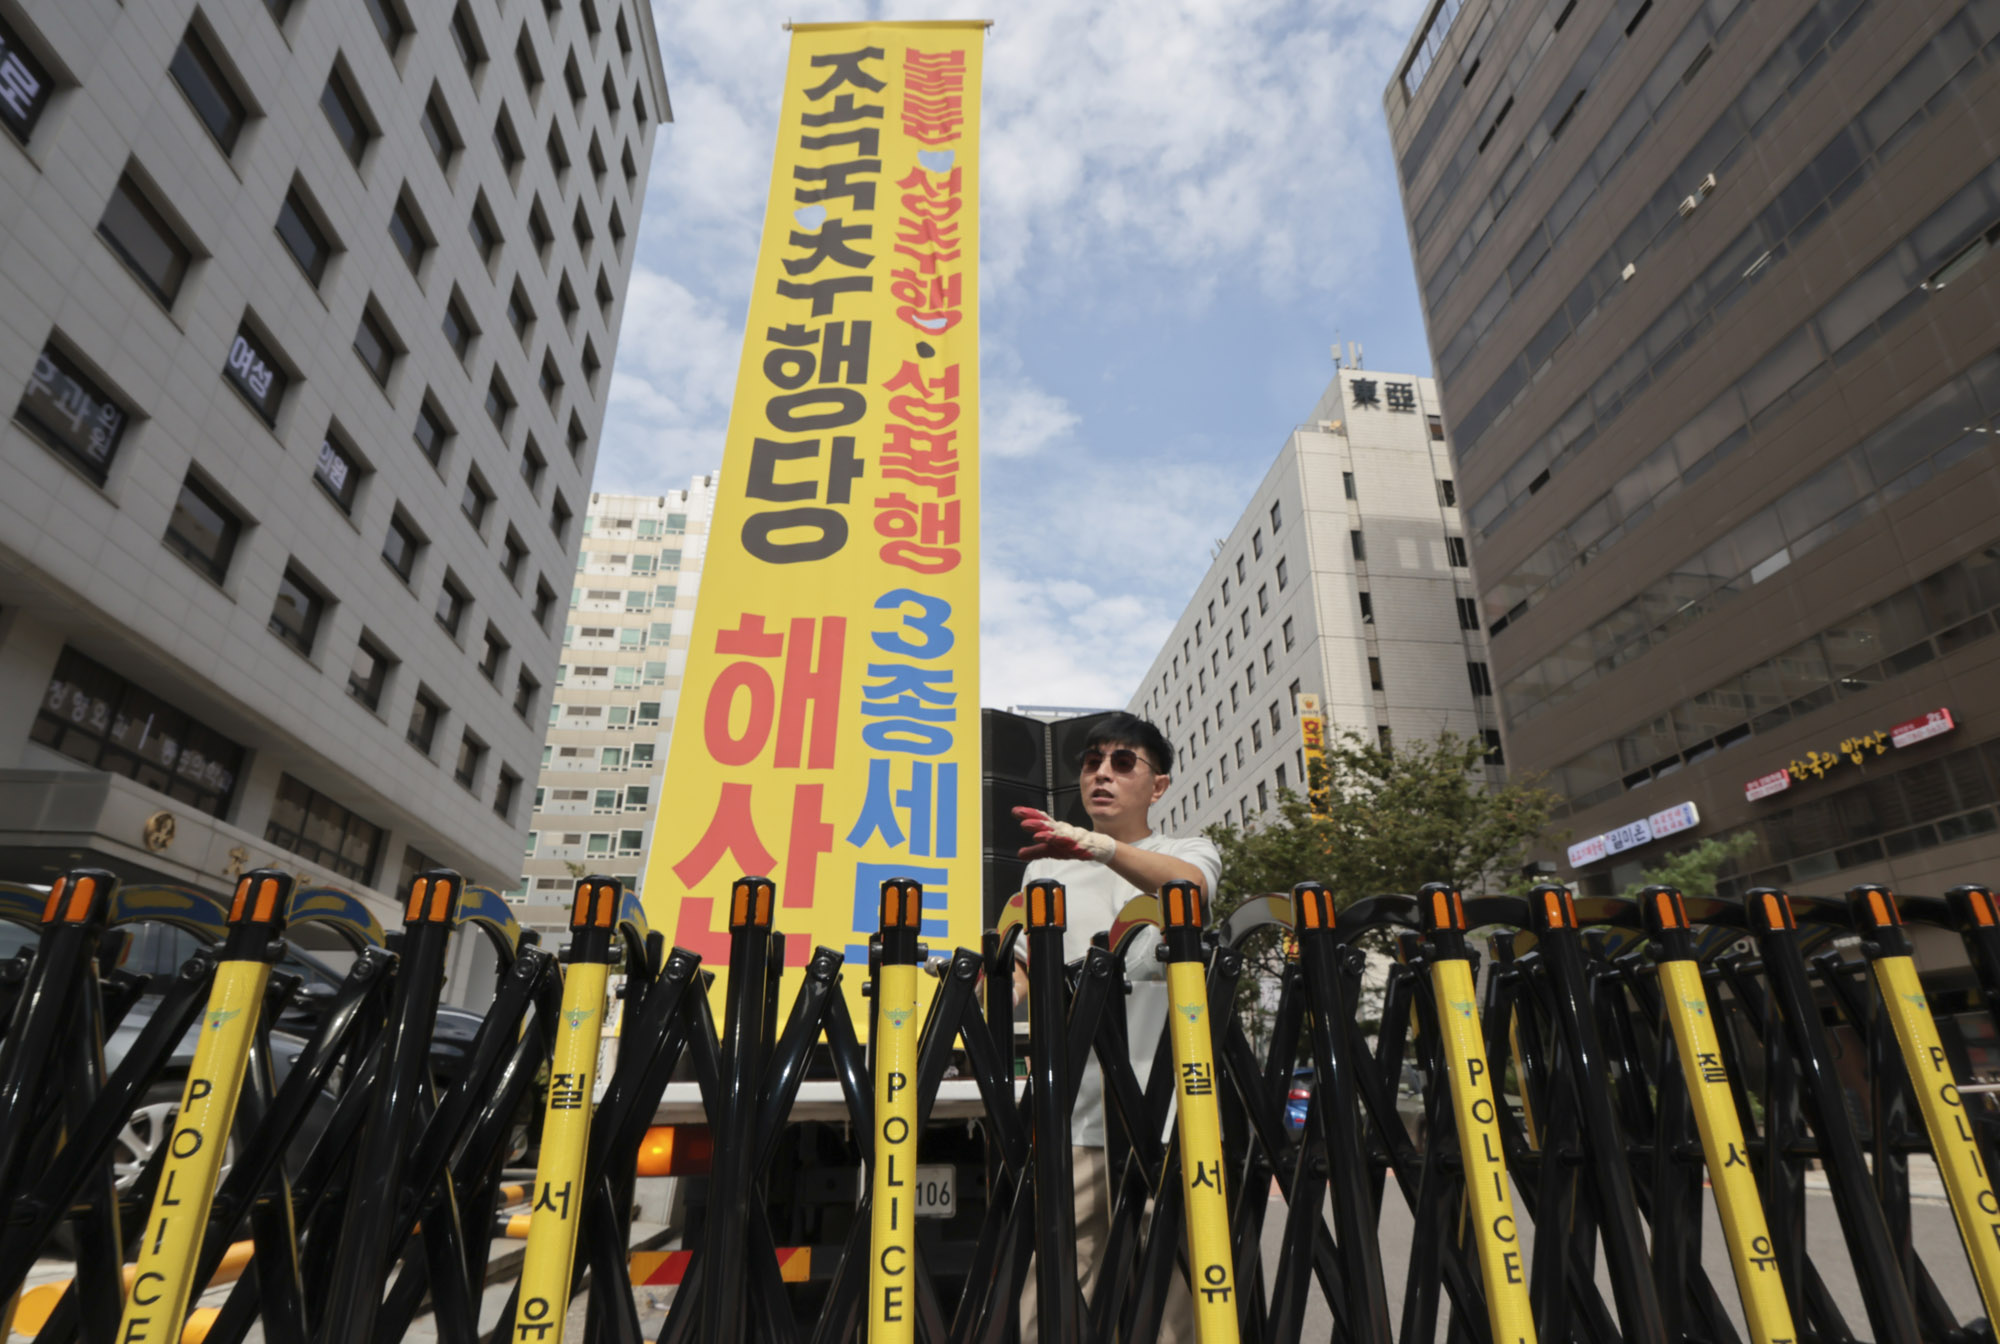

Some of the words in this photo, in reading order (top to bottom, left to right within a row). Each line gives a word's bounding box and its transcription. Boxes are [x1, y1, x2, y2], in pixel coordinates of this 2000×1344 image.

[229, 335, 274, 399] 여성
[741, 46, 888, 565] 조국추행당
[1350, 377, 1417, 414] 東亞
[672, 612, 847, 968] 해산
[845, 588, 958, 968] 3종세트
[1788, 750, 1839, 781] 한국의
[1840, 730, 1887, 766] 밥상
[123, 1078, 212, 1344] POLICE
[516, 1073, 586, 1341] 질서유
[880, 1072, 909, 1322] POLICE
[1182, 1062, 1233, 1304] 질서유
[1467, 1058, 1523, 1285] POLICE
